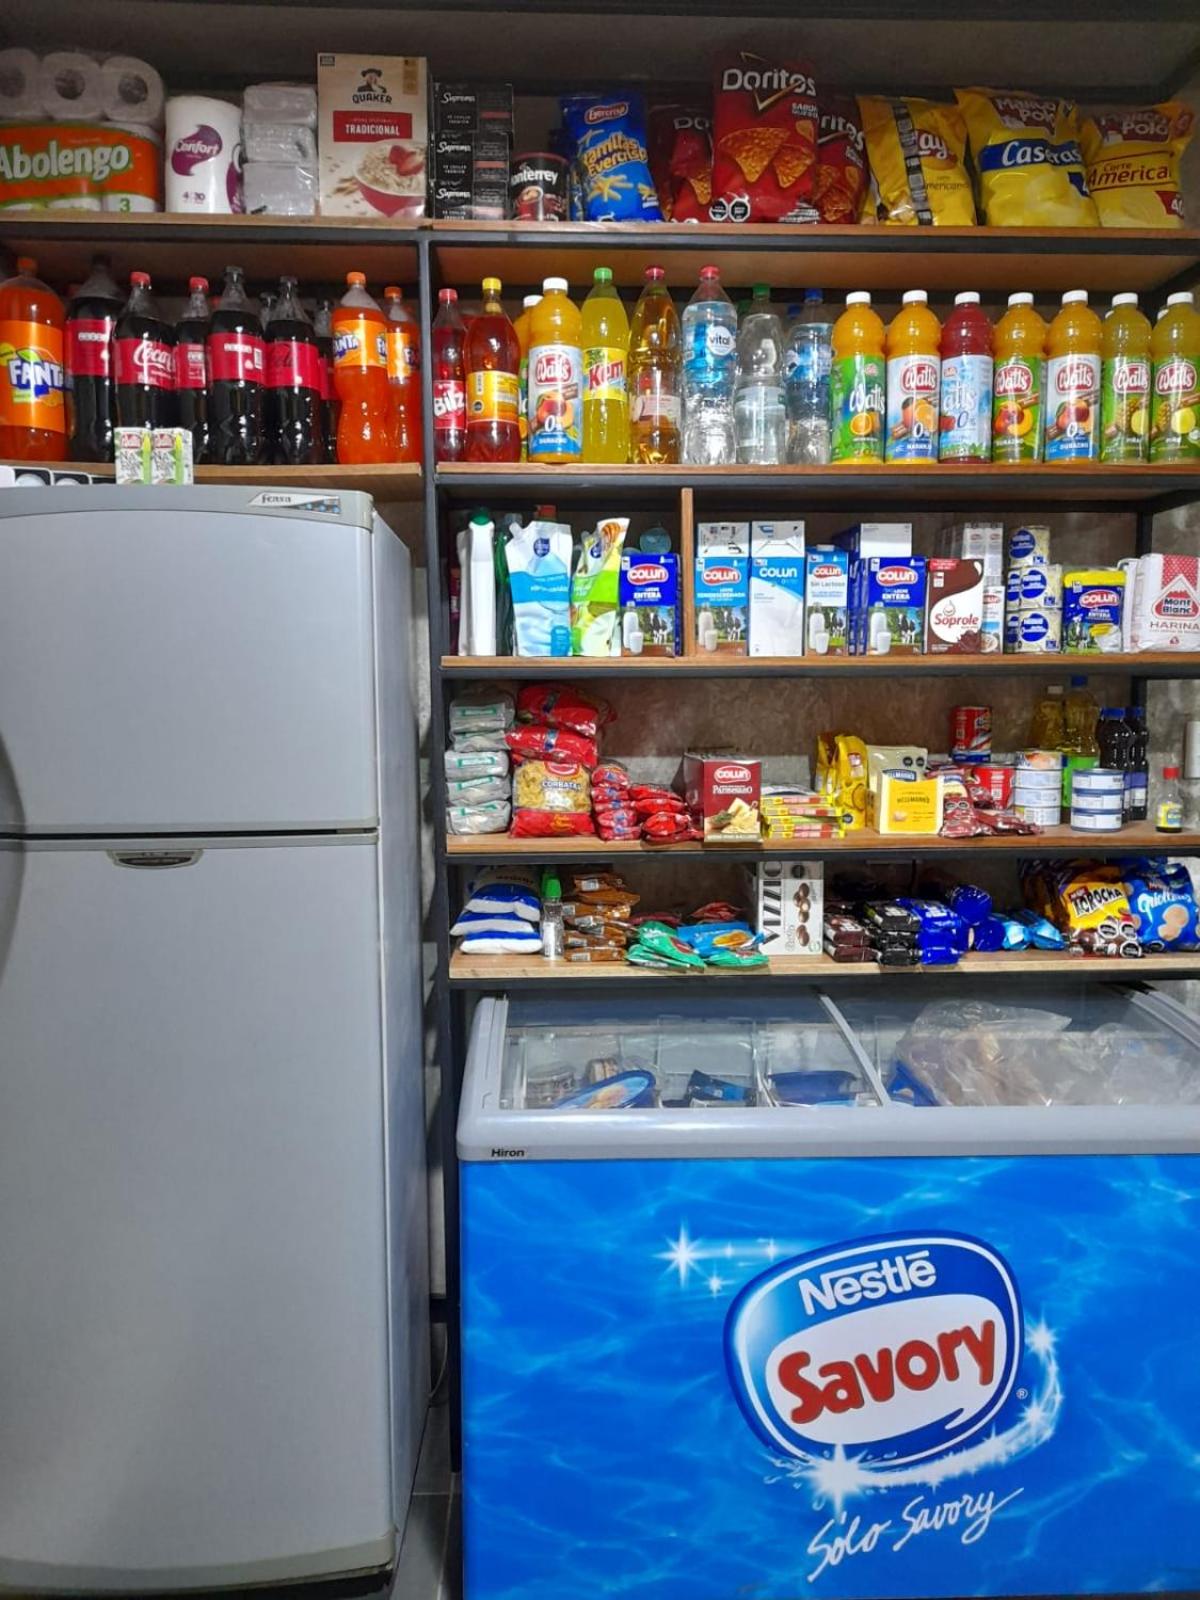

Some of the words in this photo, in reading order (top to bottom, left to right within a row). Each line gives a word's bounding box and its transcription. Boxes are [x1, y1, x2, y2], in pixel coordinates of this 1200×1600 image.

[722, 69, 817, 97] Doritos
[352, 93, 393, 104] QUAKER
[345, 123, 400, 136] TRADICIONAL
[821, 115, 864, 149] ritos
[174, 139, 220, 155] Confort
[0, 140, 129, 181] Abolengo
[1103, 161, 1133, 173] Corte
[510, 169, 559, 186] onterrey
[119, 198, 130, 212] 3
[433, 391, 465, 417] Bilz
[633, 591, 662, 599] ENTERA
[1164, 598, 1192, 606] Mont
[1163, 605, 1192, 614] Blanc
[934, 612, 980, 628] Soprole
[1150, 621, 1200, 630] HARINA
[491, 1148, 526, 1157] Hiron
[778, 1319, 996, 1425] Savory
[806, 1510, 893, 1583] Sólo
[891, 1486, 1025, 1552] Savory
